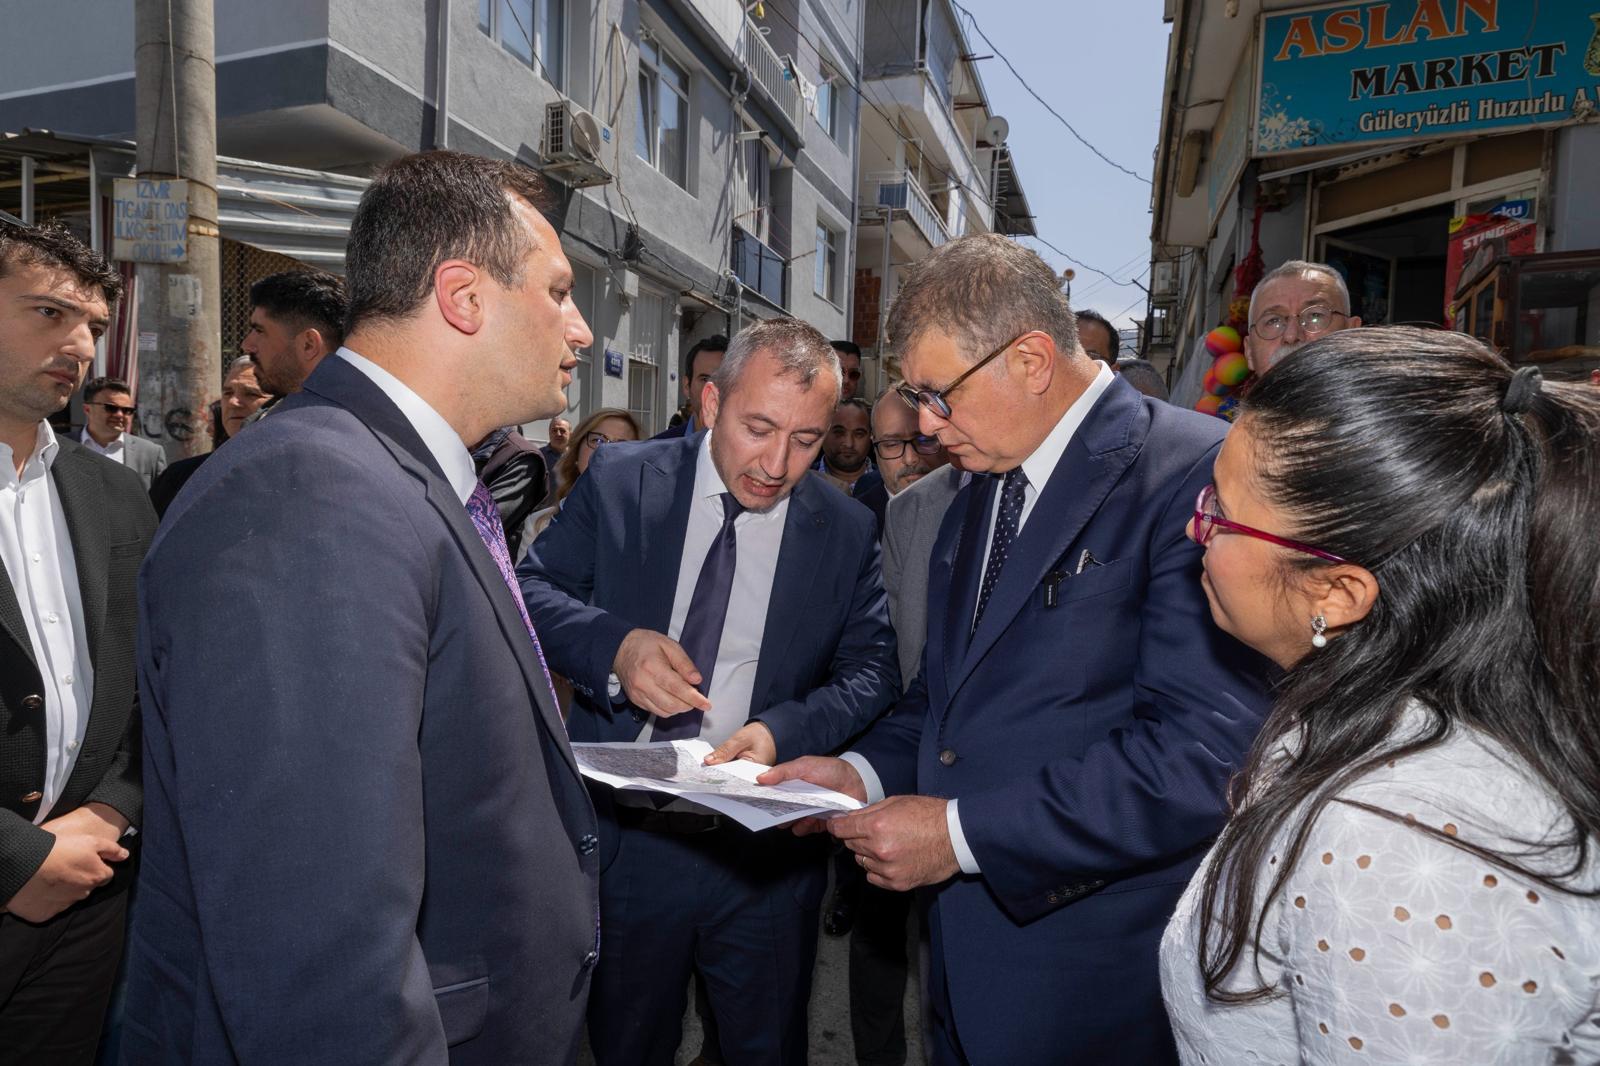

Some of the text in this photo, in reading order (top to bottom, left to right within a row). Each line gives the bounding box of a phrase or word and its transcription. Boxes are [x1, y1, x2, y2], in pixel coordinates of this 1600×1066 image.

[1273, 0, 1500, 61] ASLAN
[1349, 41, 1567, 101] MARKET
[1359, 99, 1470, 133] Güleryüzlü
[1477, 91, 1565, 120] Huzurlu
[1462, 224, 1506, 251] STING
